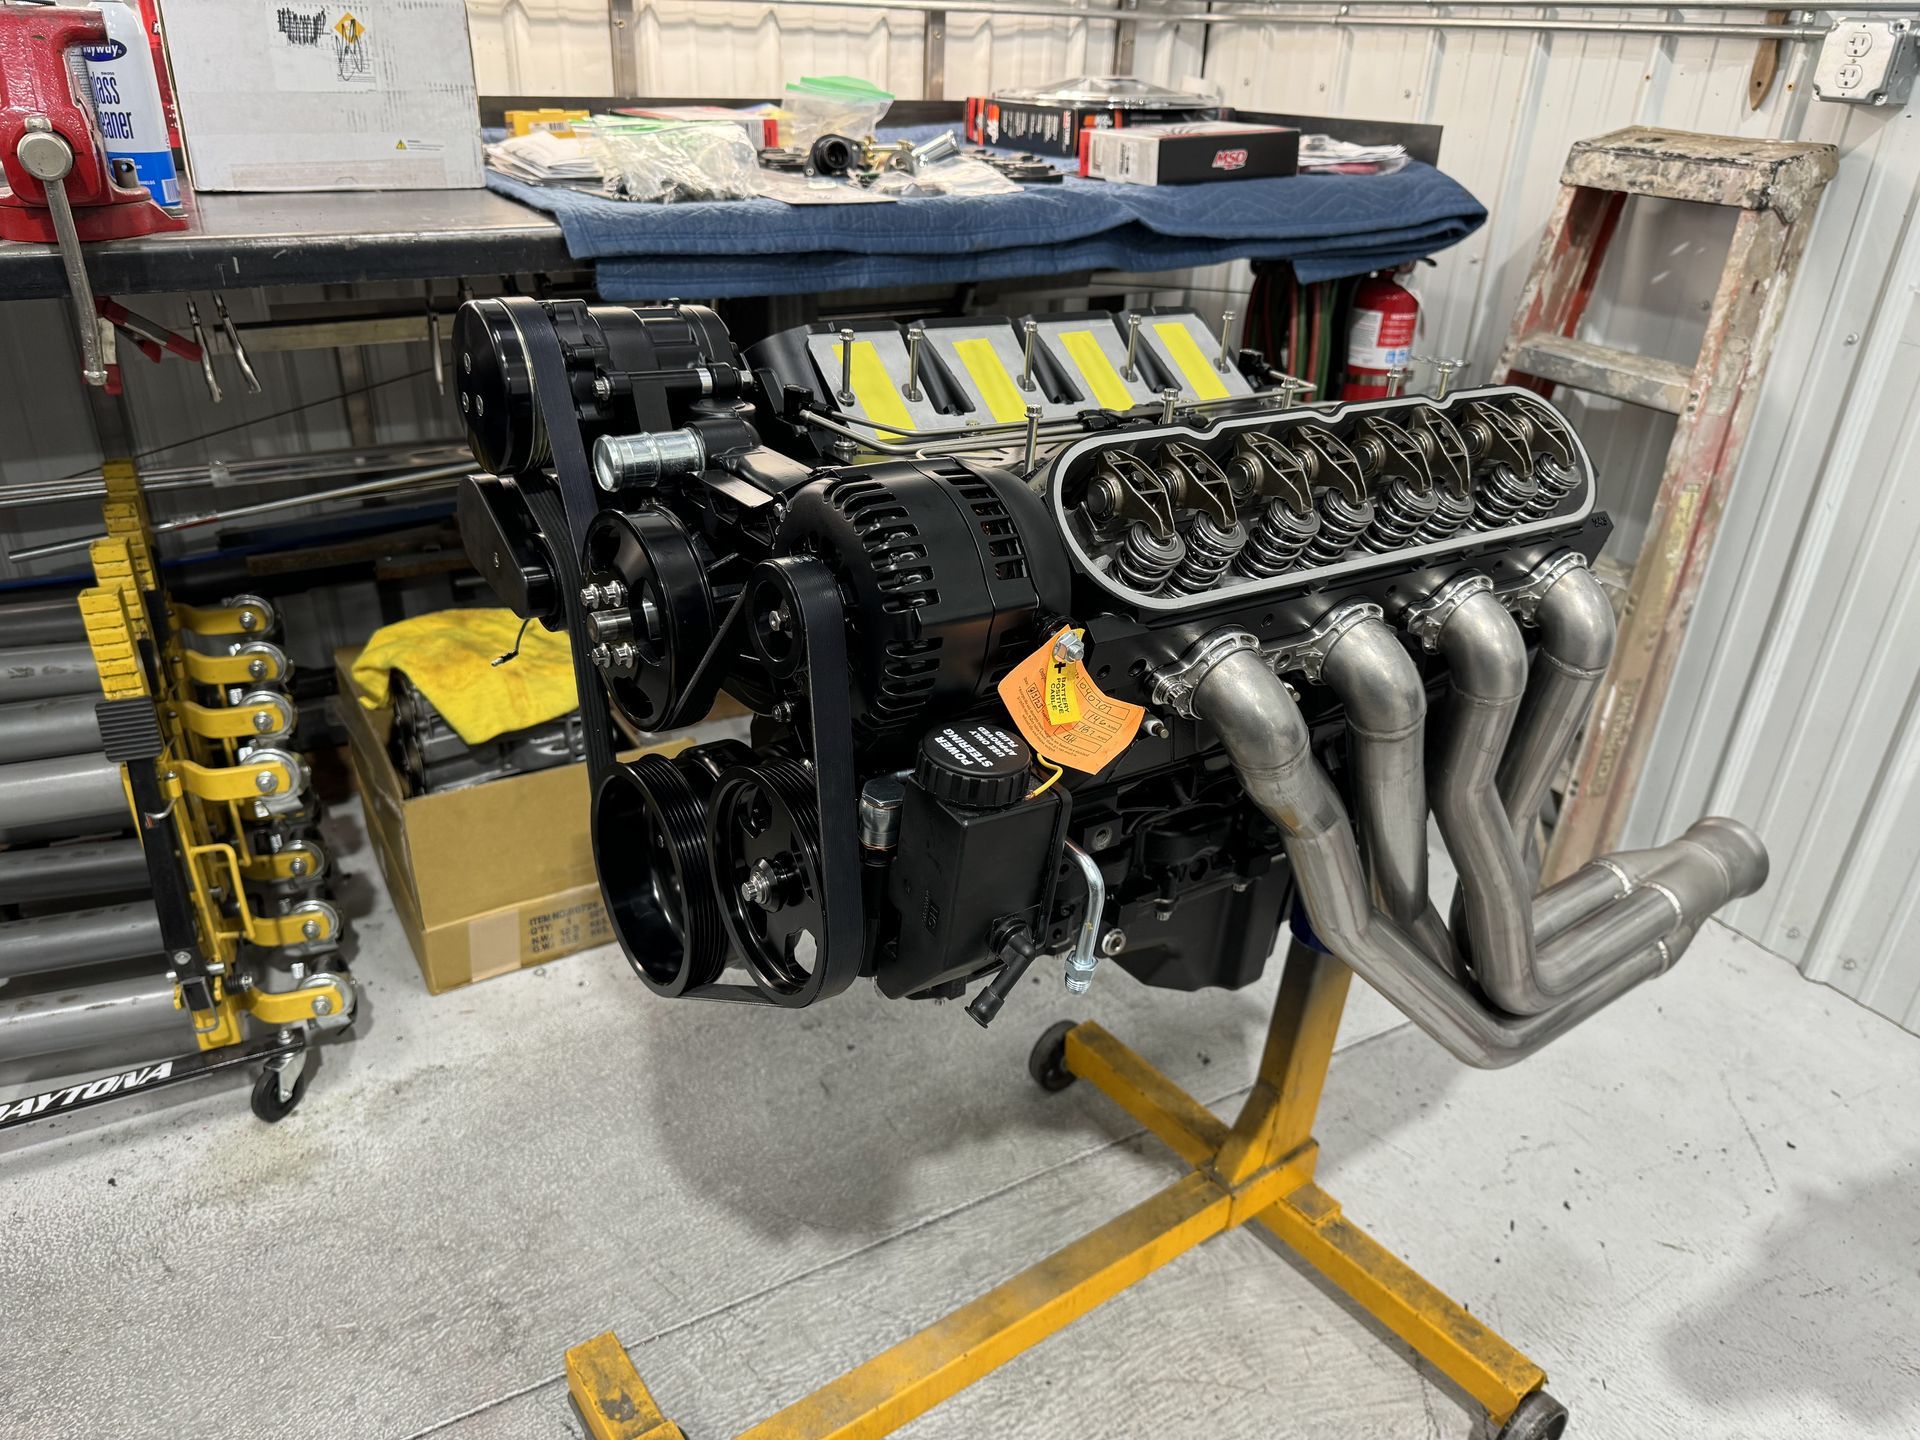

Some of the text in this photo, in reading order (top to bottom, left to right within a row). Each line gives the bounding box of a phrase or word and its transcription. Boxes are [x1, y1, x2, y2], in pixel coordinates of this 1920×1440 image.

[100, 111, 135, 139] eaner
[1050, 683, 1058, 711] CABLE
[1056, 677, 1065, 714] POSITIVE
[1061, 676, 1070, 713] BATTERY
[934, 736, 974, 766] POWER
[943, 728, 994, 767] STEERING
[968, 730, 1006, 758] USE ONLY
[977, 726, 1018, 756] APPROVED
[994, 731, 1019, 748] FLUID
